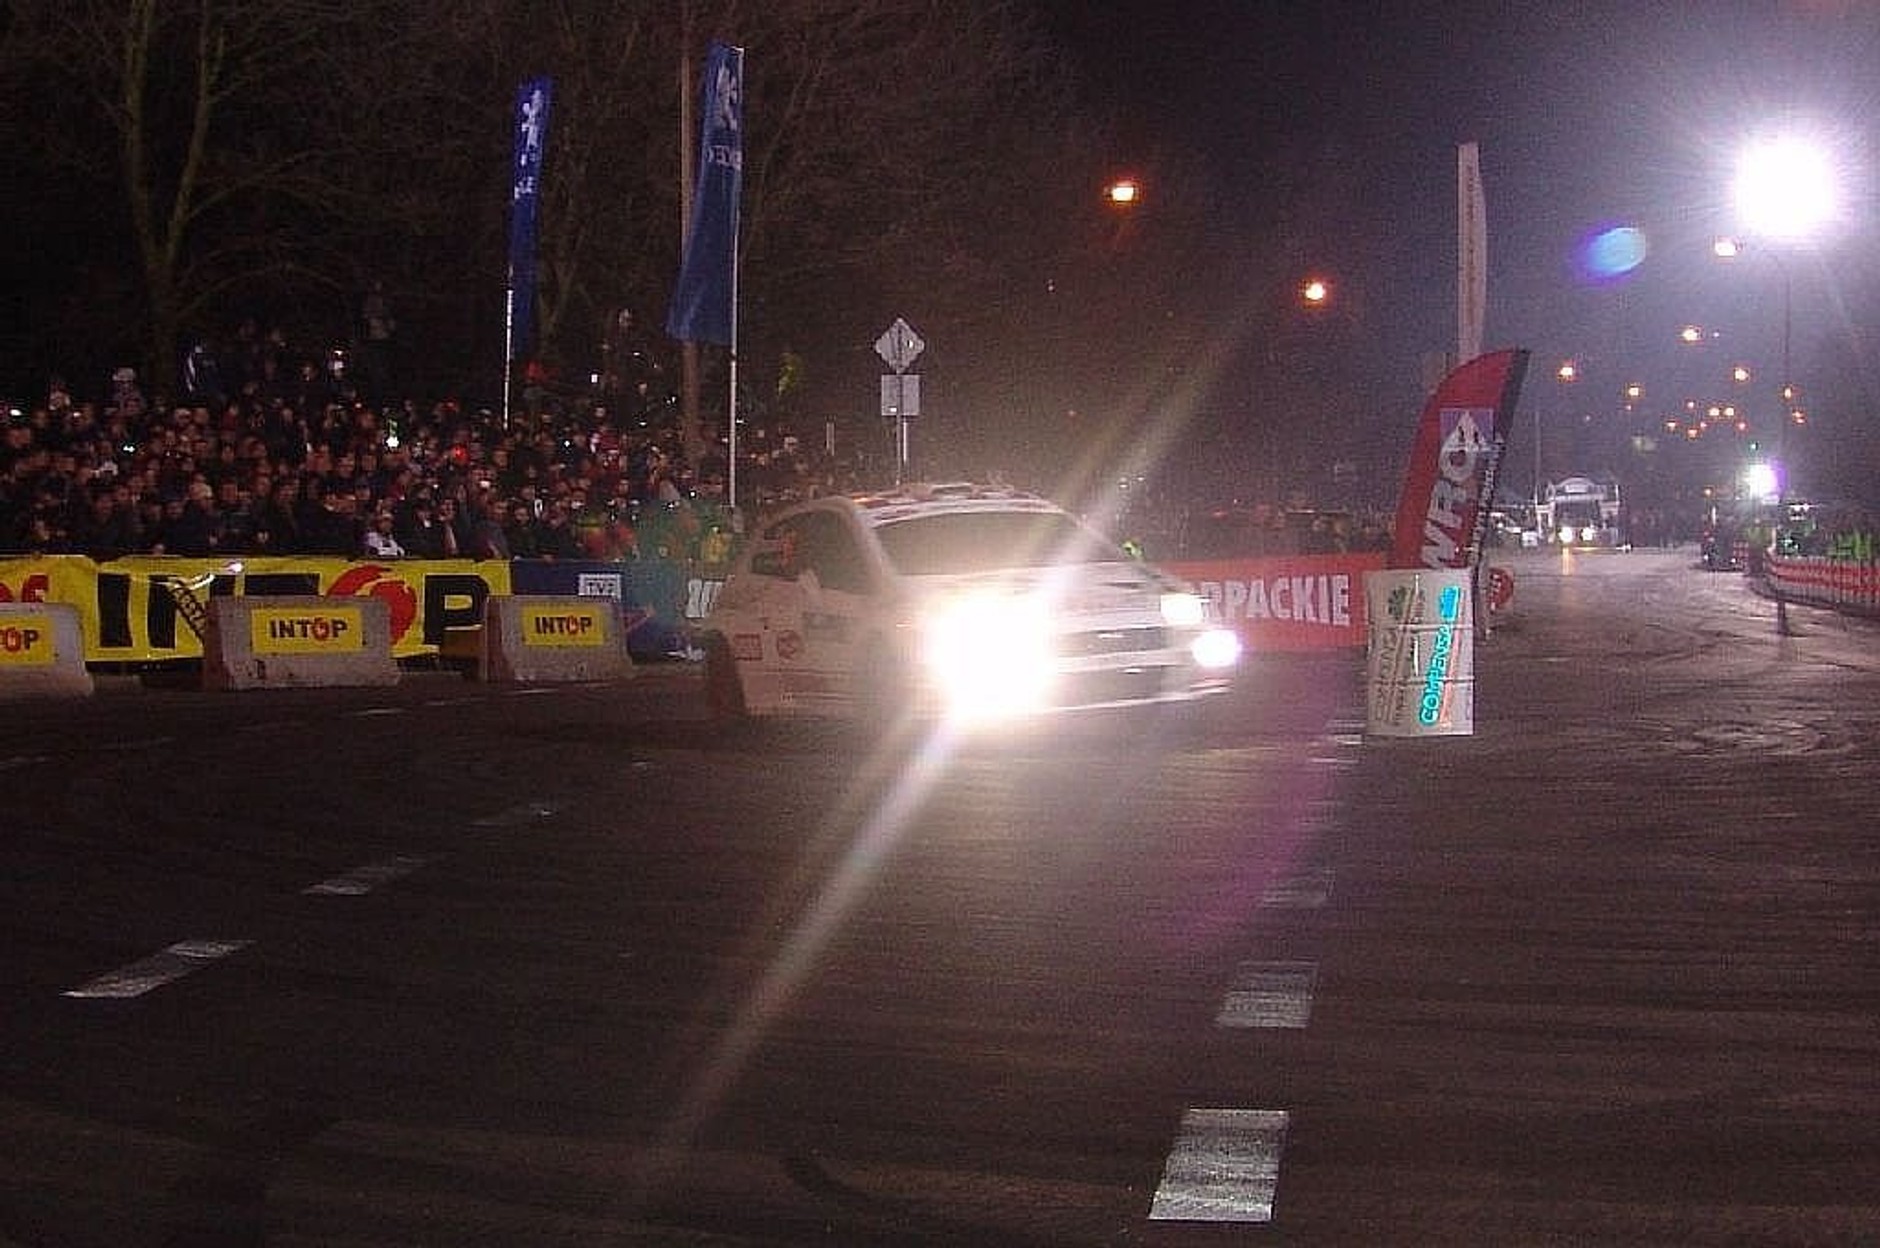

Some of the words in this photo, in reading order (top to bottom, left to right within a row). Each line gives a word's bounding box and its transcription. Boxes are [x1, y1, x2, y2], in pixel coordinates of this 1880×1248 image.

[1198, 575, 1350, 626] RPACKIE
[270, 617, 347, 641] INTOP
[535, 615, 592, 635] INTOP
[0, 627, 39, 652] OP
